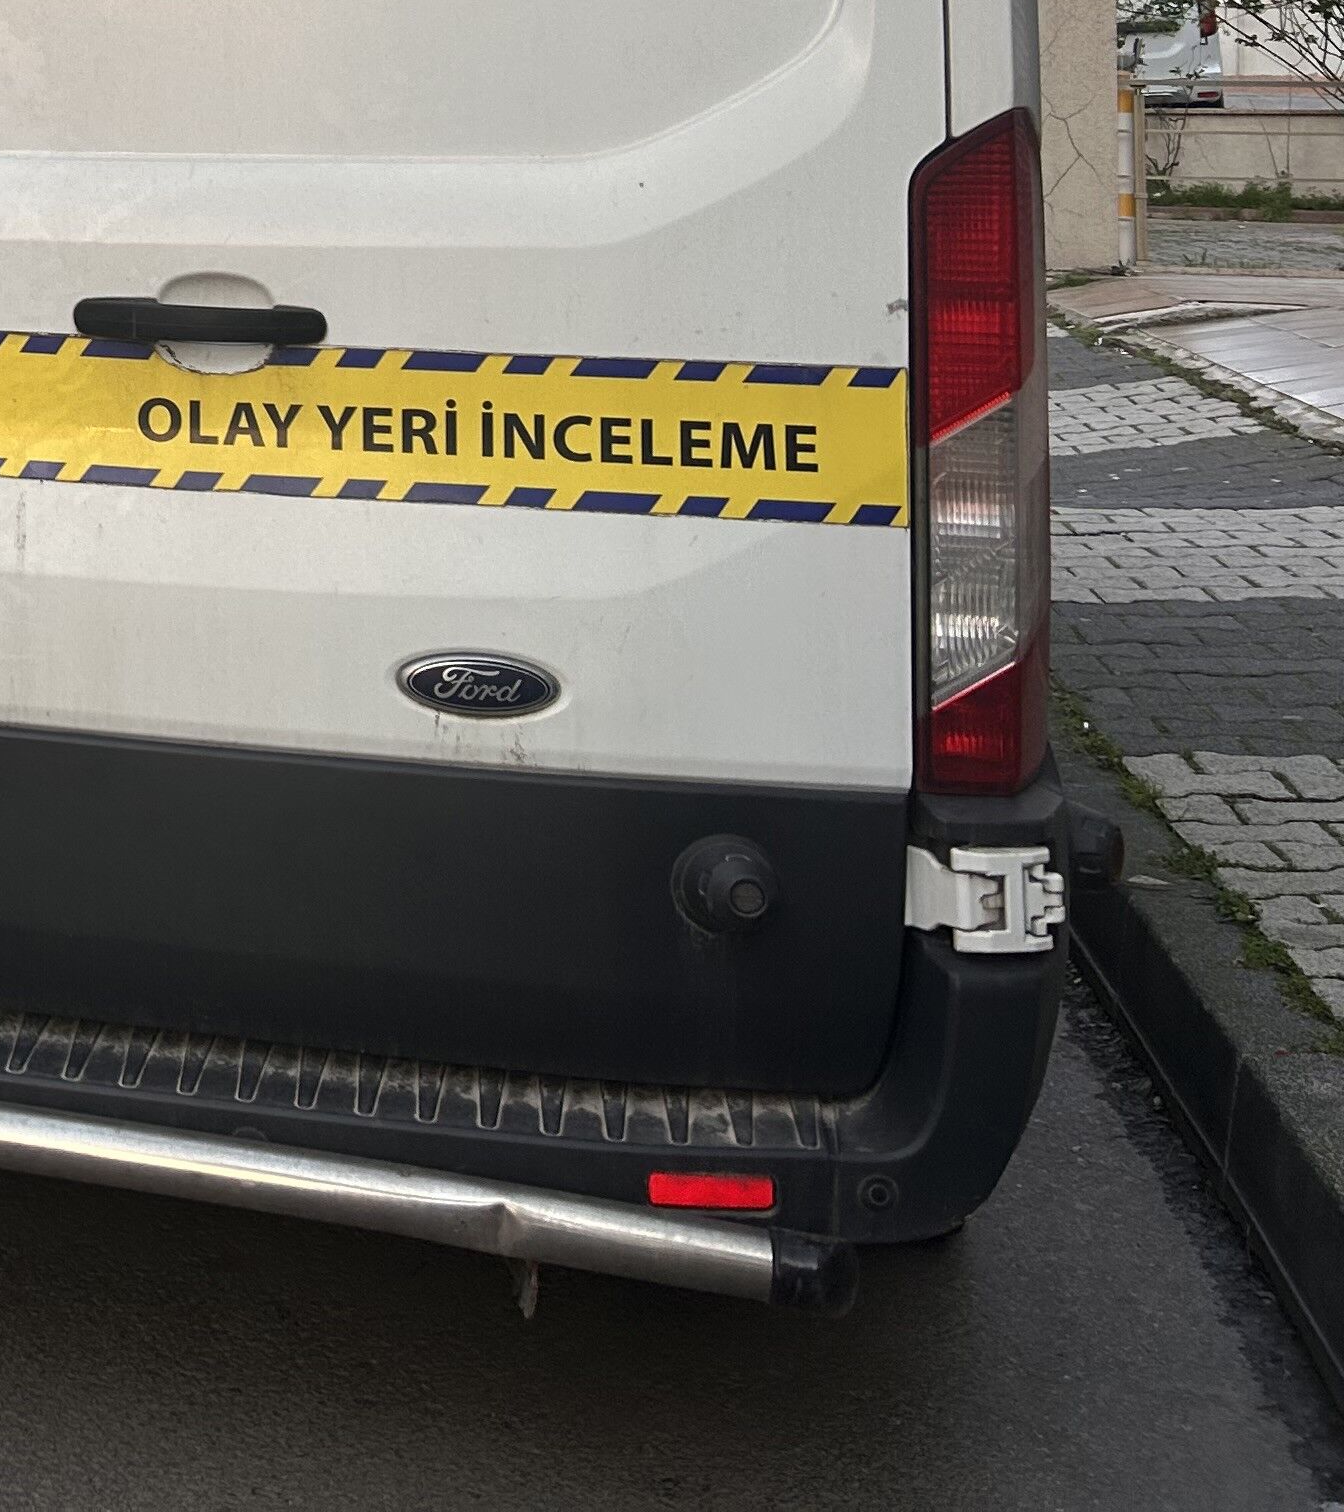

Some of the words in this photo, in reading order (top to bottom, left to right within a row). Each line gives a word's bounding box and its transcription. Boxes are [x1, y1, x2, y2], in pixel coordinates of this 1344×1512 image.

[137, 396, 302, 448] OLAY
[317, 398, 459, 458] YERİ
[480, 399, 820, 473] İNCELEME
[433, 666, 522, 702] Ford
